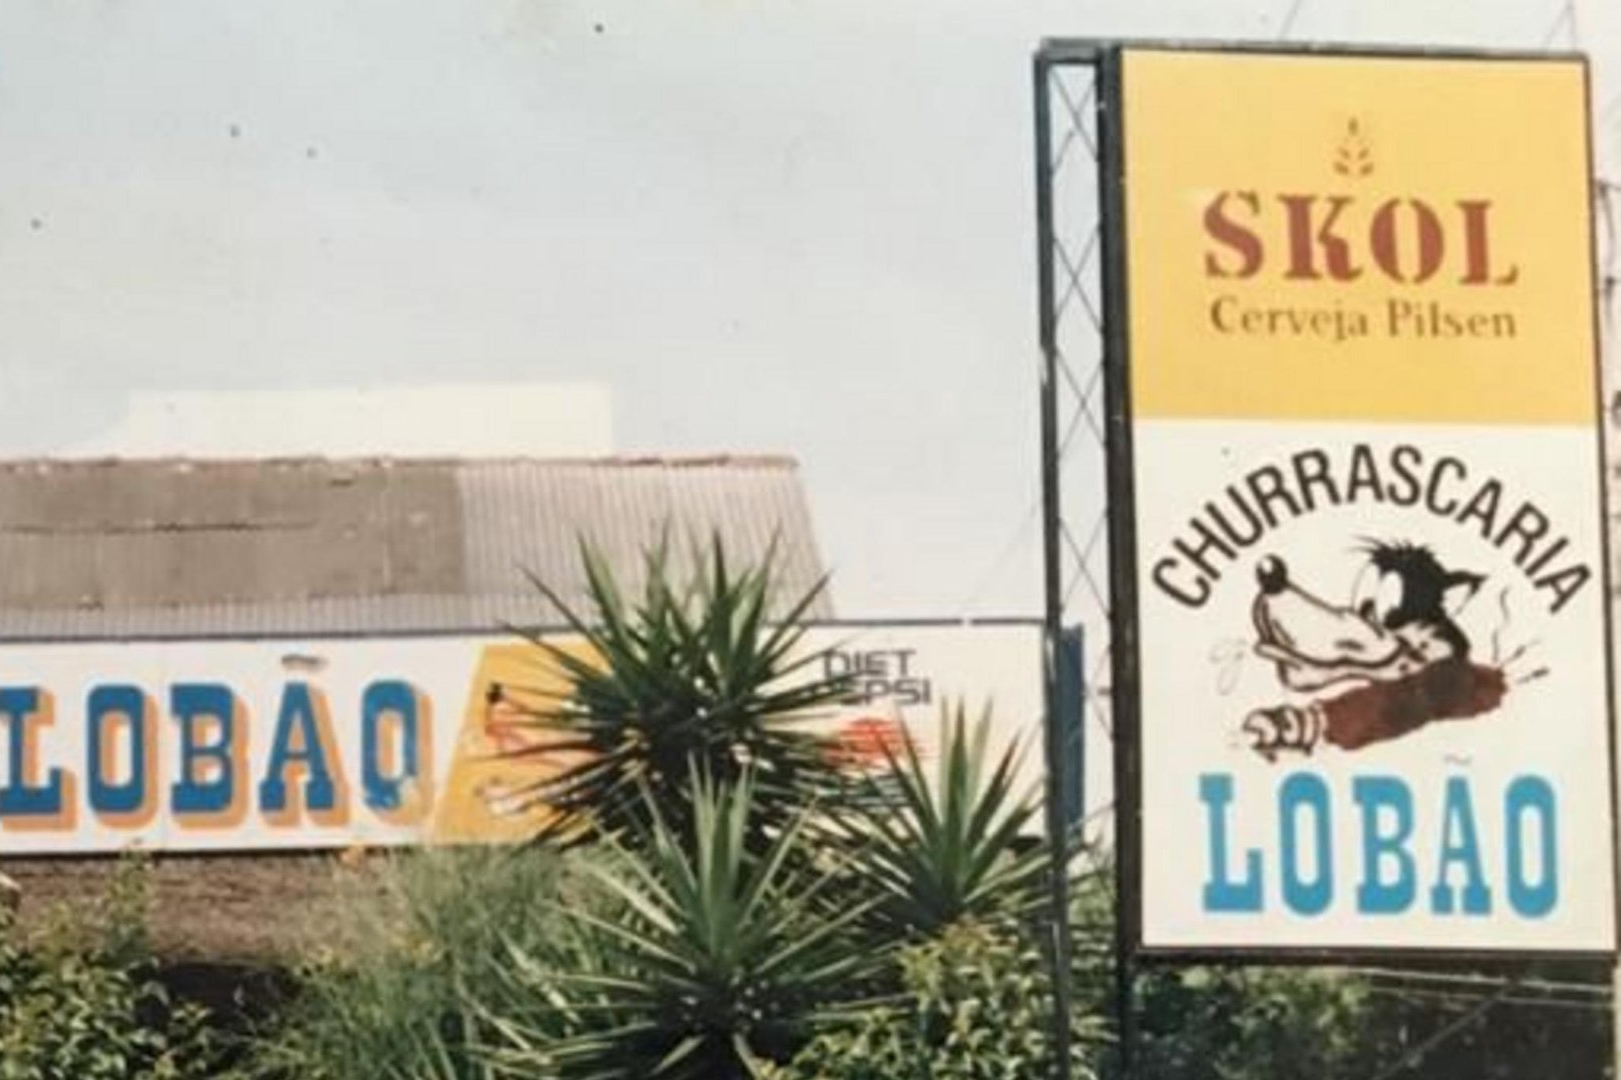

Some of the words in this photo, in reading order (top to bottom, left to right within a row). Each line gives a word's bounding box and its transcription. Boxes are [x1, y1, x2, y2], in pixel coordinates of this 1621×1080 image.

[1202, 189, 1519, 286] SKOL
[1210, 296, 1370, 342] Cerveja
[1387, 299, 1518, 340] Pilsen
[1150, 443, 1592, 614] CHURRASCARIA
[820, 677, 934, 706] PSI
[1197, 755, 1561, 920] LOBÃO
